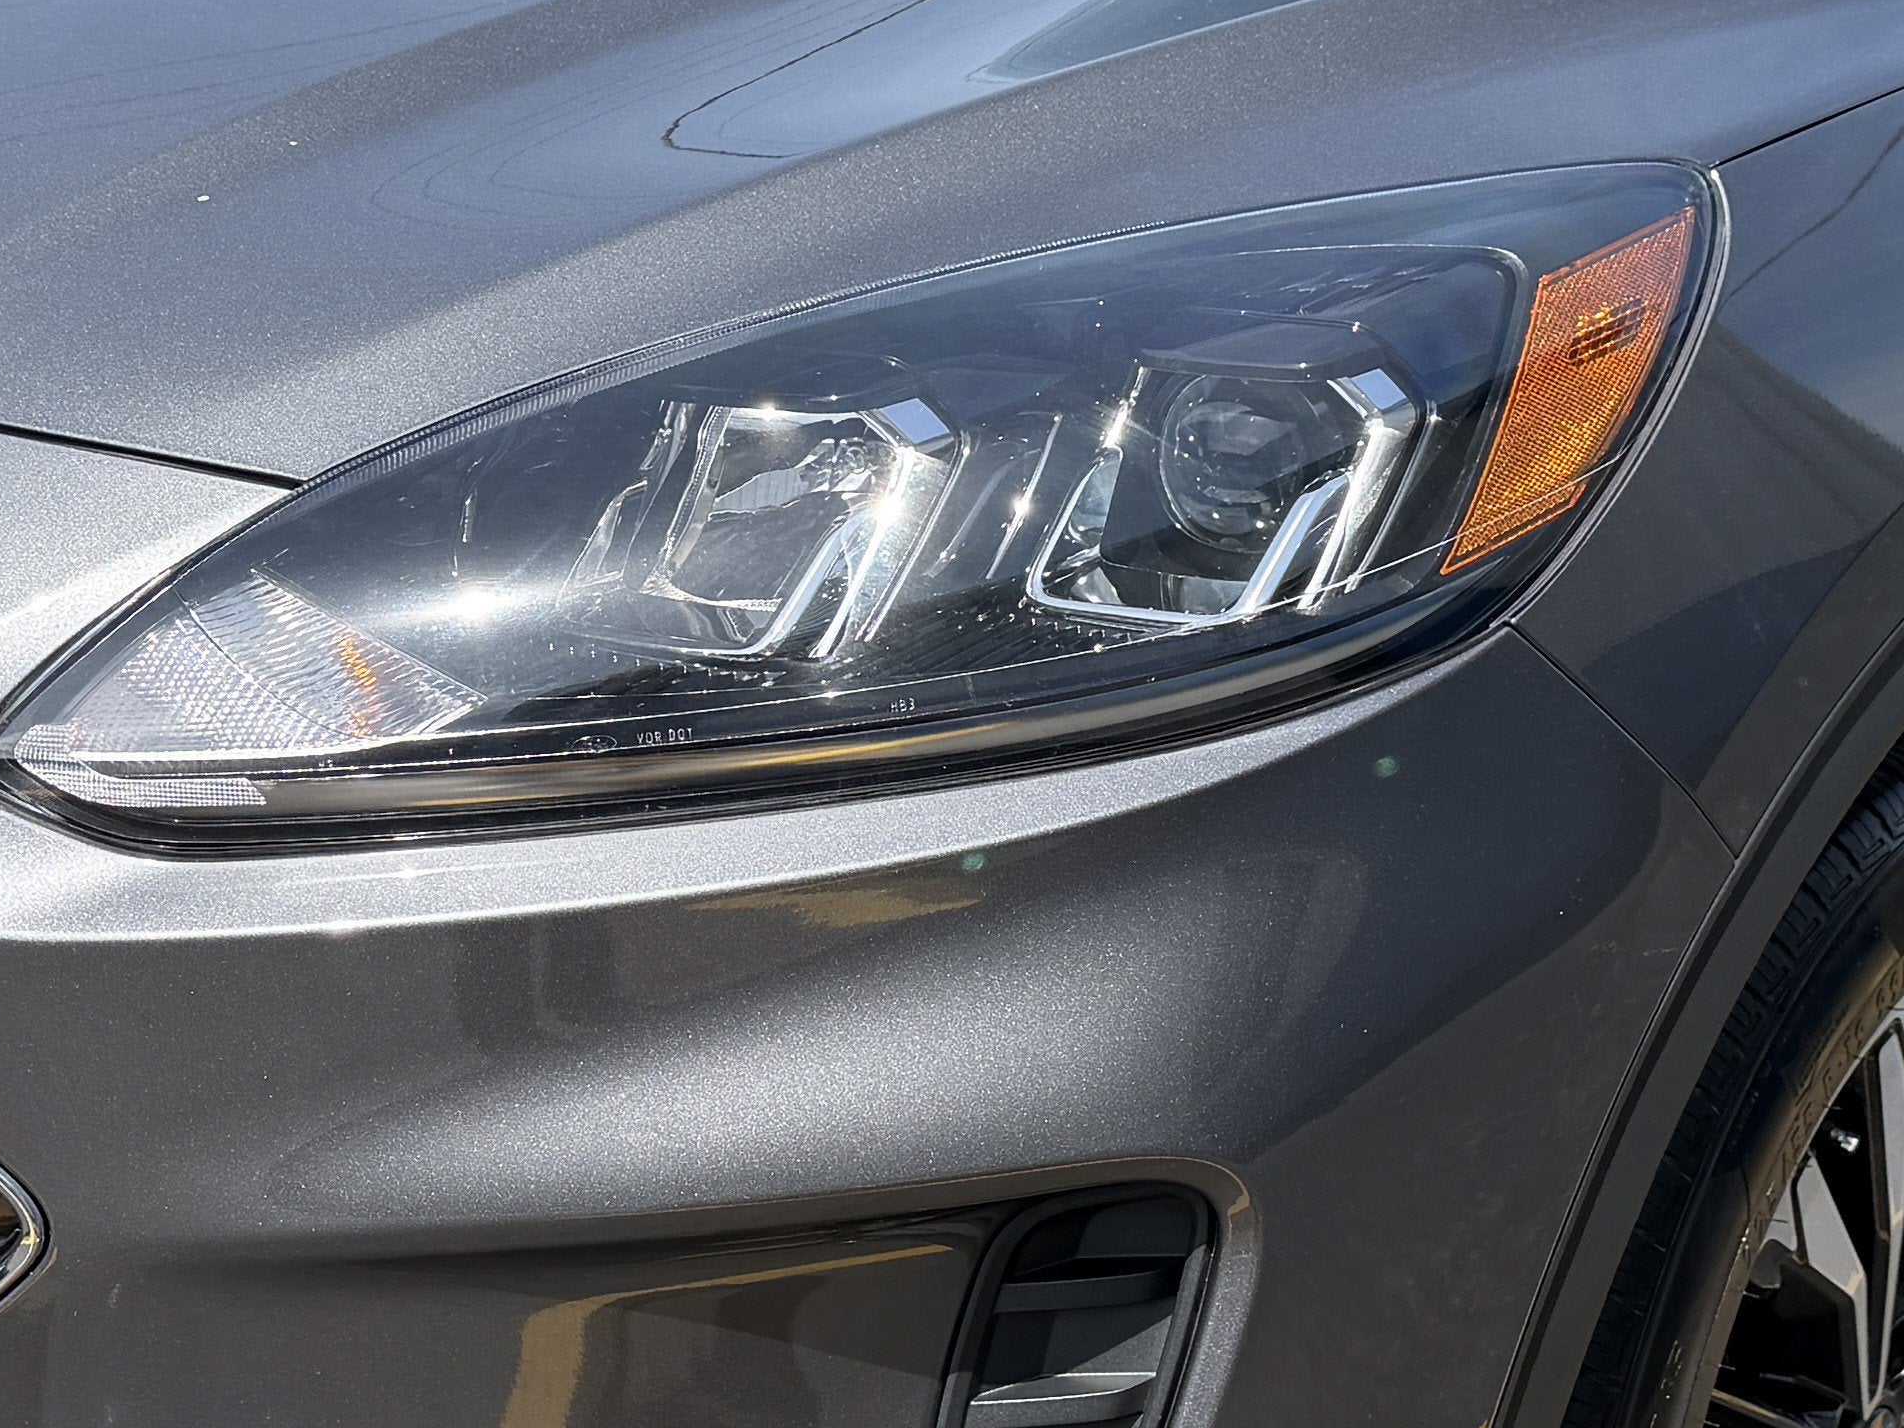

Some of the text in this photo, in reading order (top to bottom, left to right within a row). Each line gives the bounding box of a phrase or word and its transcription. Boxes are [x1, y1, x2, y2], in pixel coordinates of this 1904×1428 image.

[889, 697, 916, 714] HB3
[635, 729, 663, 745] VOR
[667, 727, 694, 743] DOT
